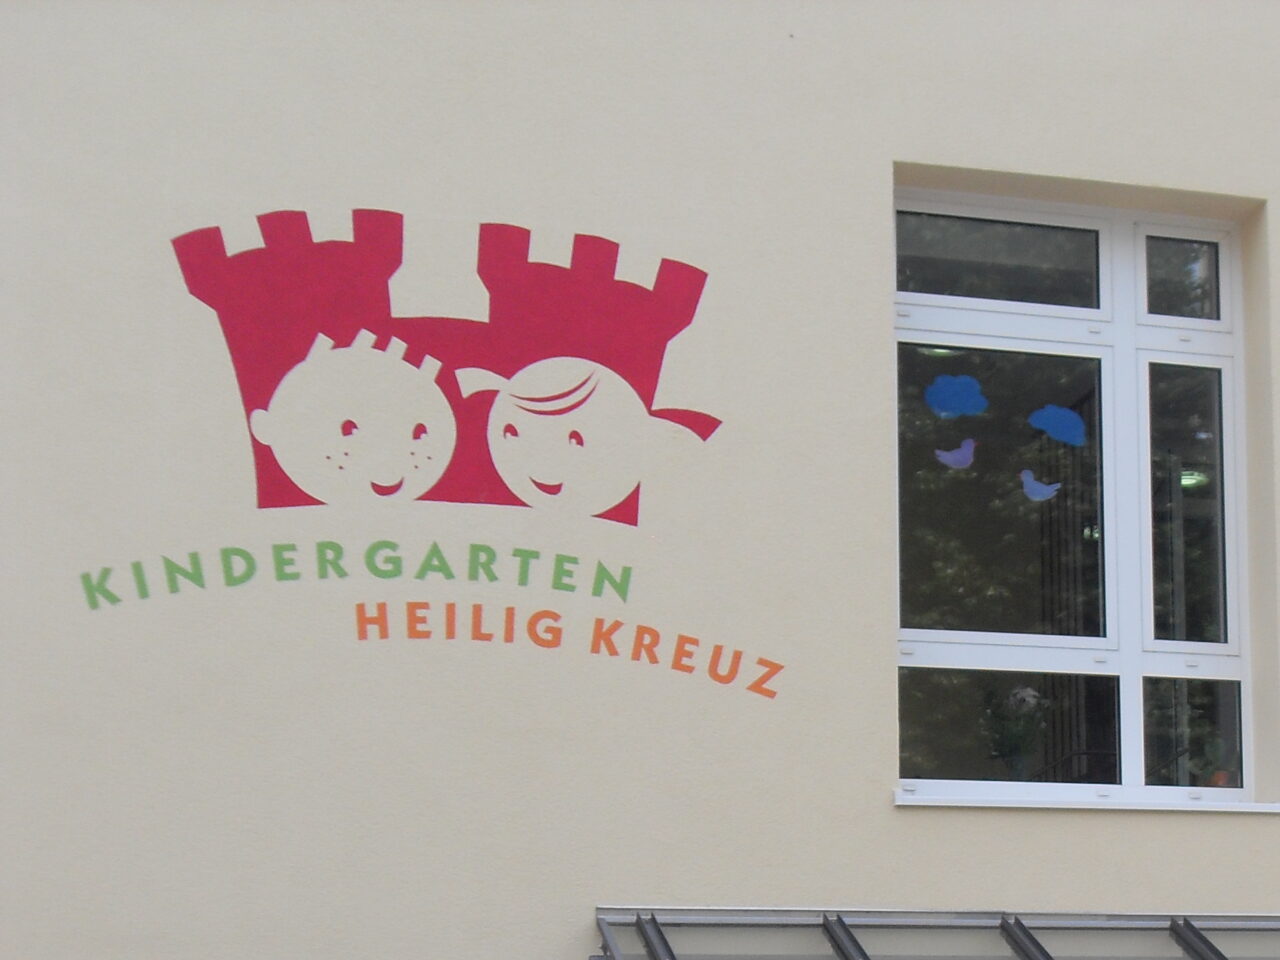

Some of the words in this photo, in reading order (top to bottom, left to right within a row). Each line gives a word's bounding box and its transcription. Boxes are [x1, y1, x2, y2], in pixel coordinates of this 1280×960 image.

[80, 540, 633, 610] KINDERGARTEN
[355, 601, 563, 649] HEILIG
[590, 617, 785, 699] KREUZ
